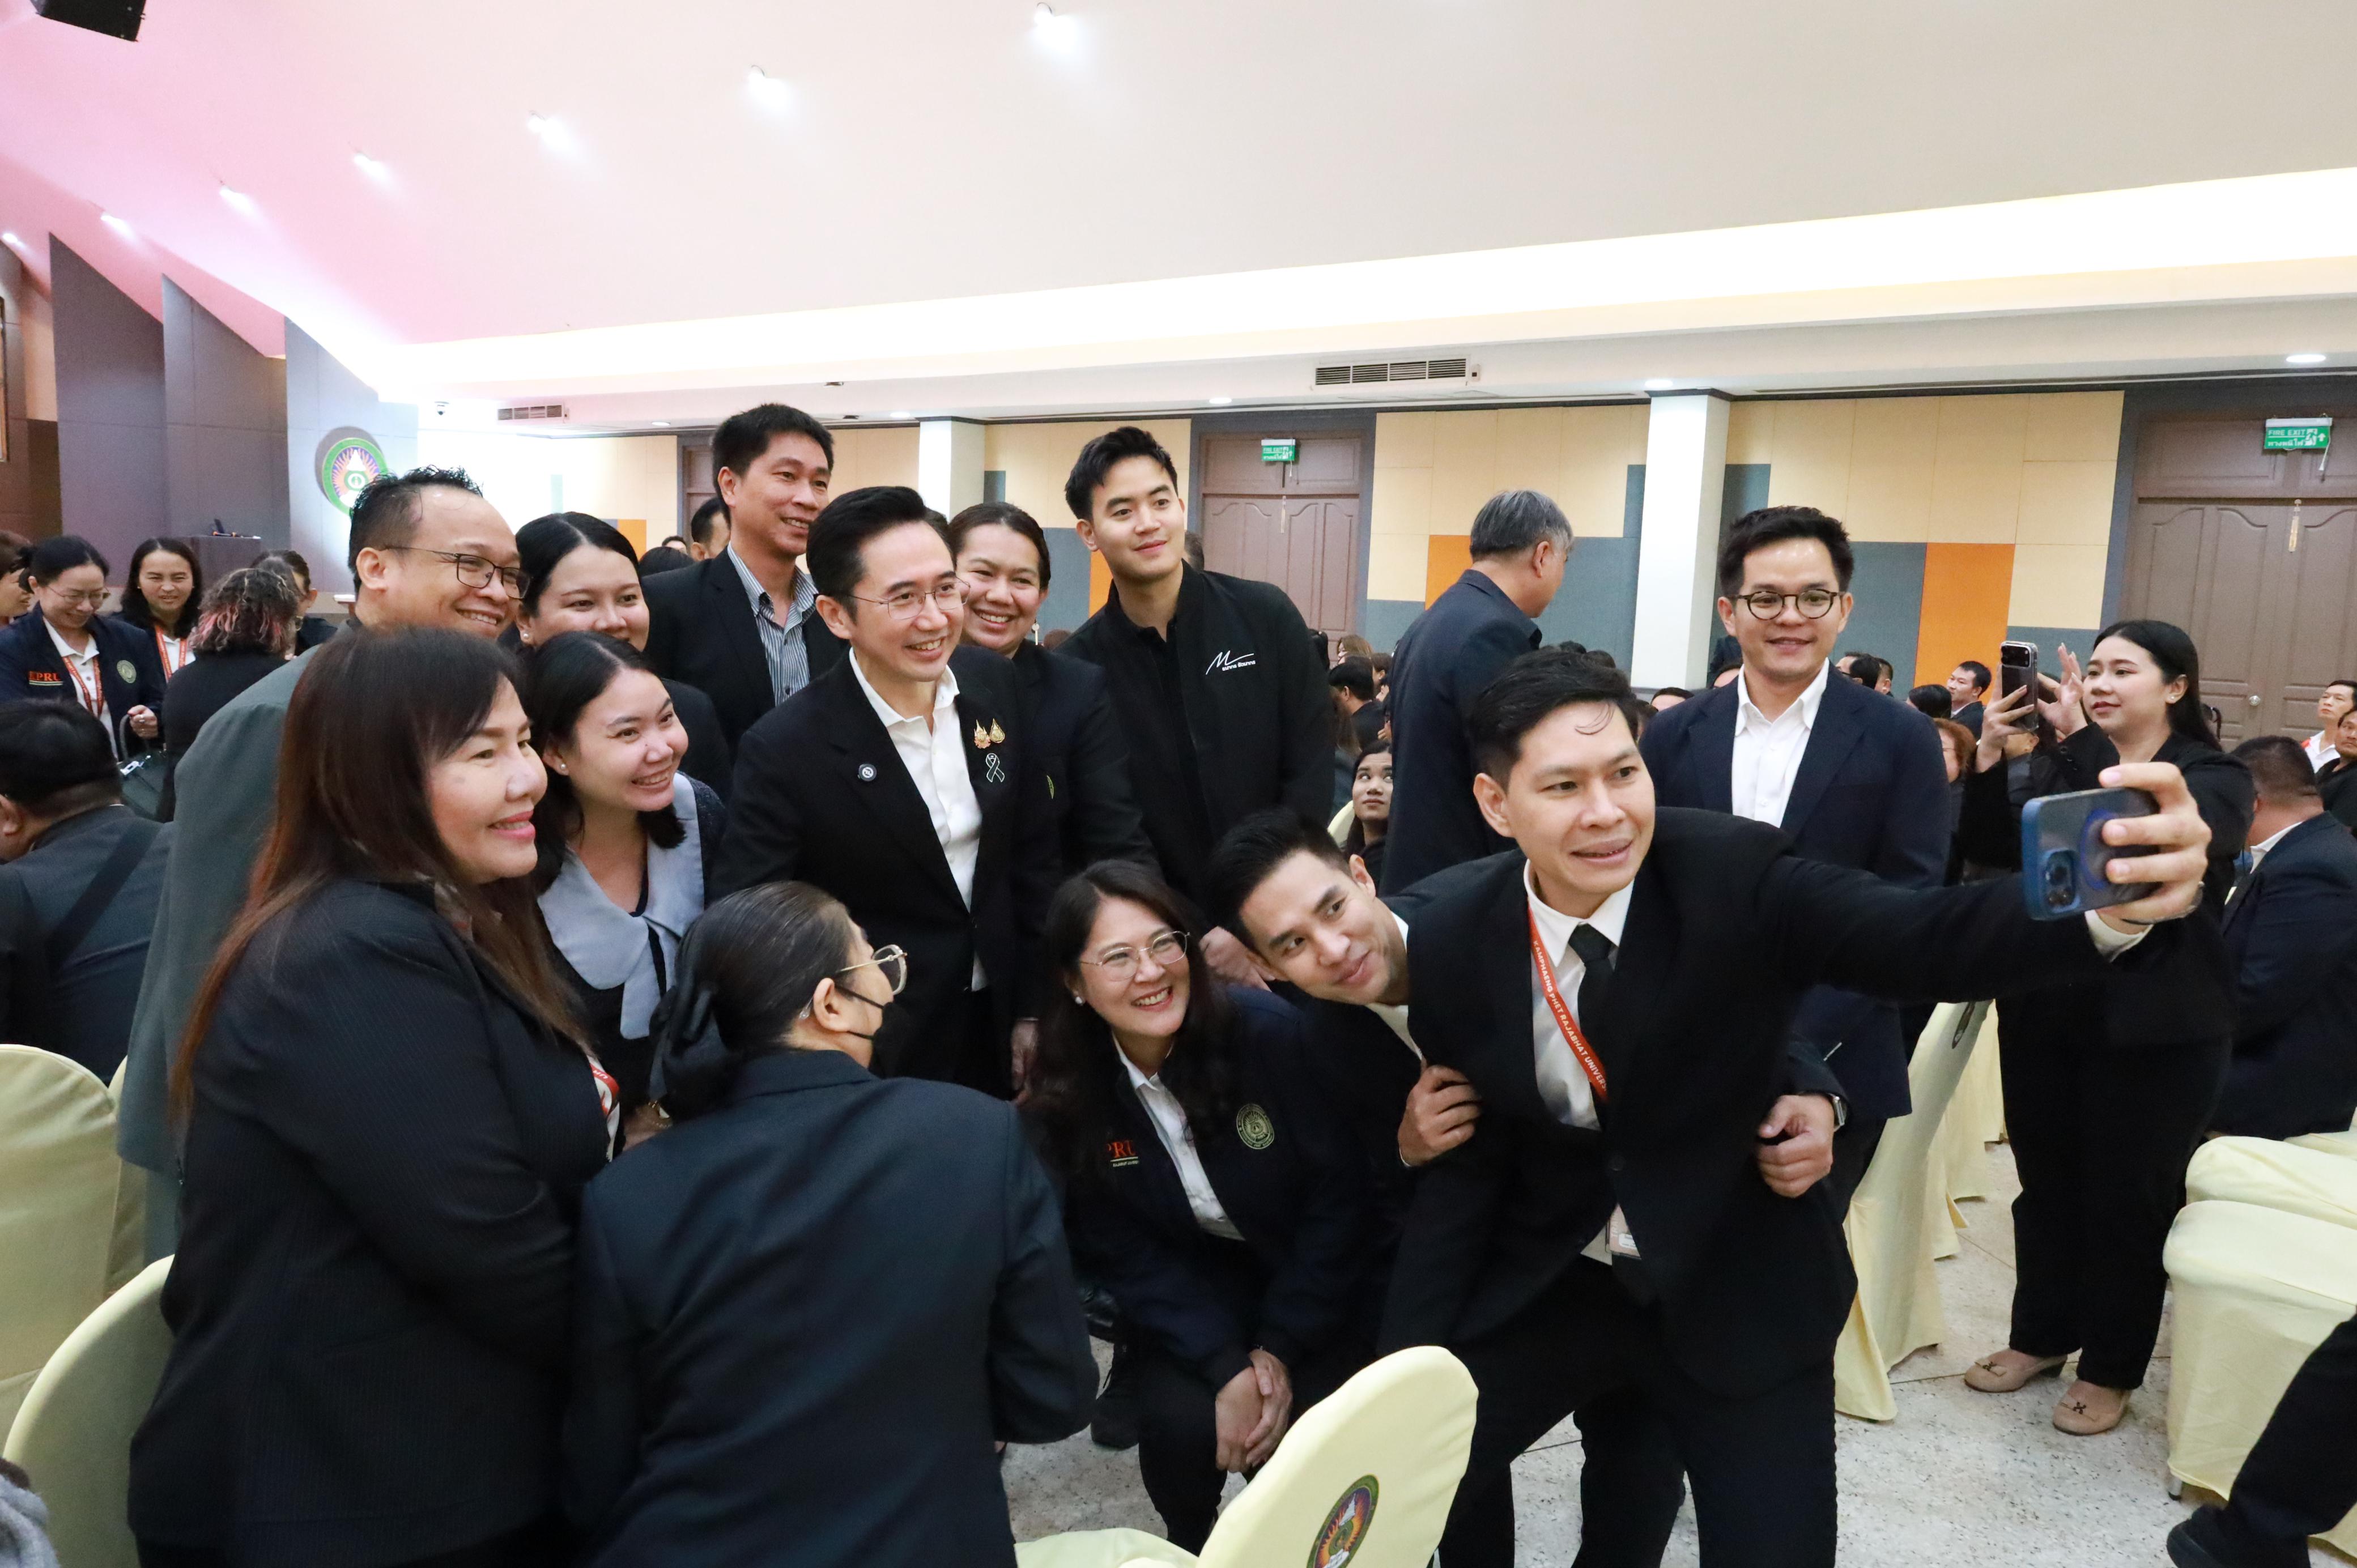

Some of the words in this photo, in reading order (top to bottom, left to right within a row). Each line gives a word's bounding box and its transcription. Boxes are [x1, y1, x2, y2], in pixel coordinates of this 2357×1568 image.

[1533, 940, 1553, 992] KAMPHAENG
[1549, 993, 1564, 1013] PHET
[1560, 1014, 1588, 1056] RAJABHAT
[1584, 1056, 1607, 1092] UNIVERS
